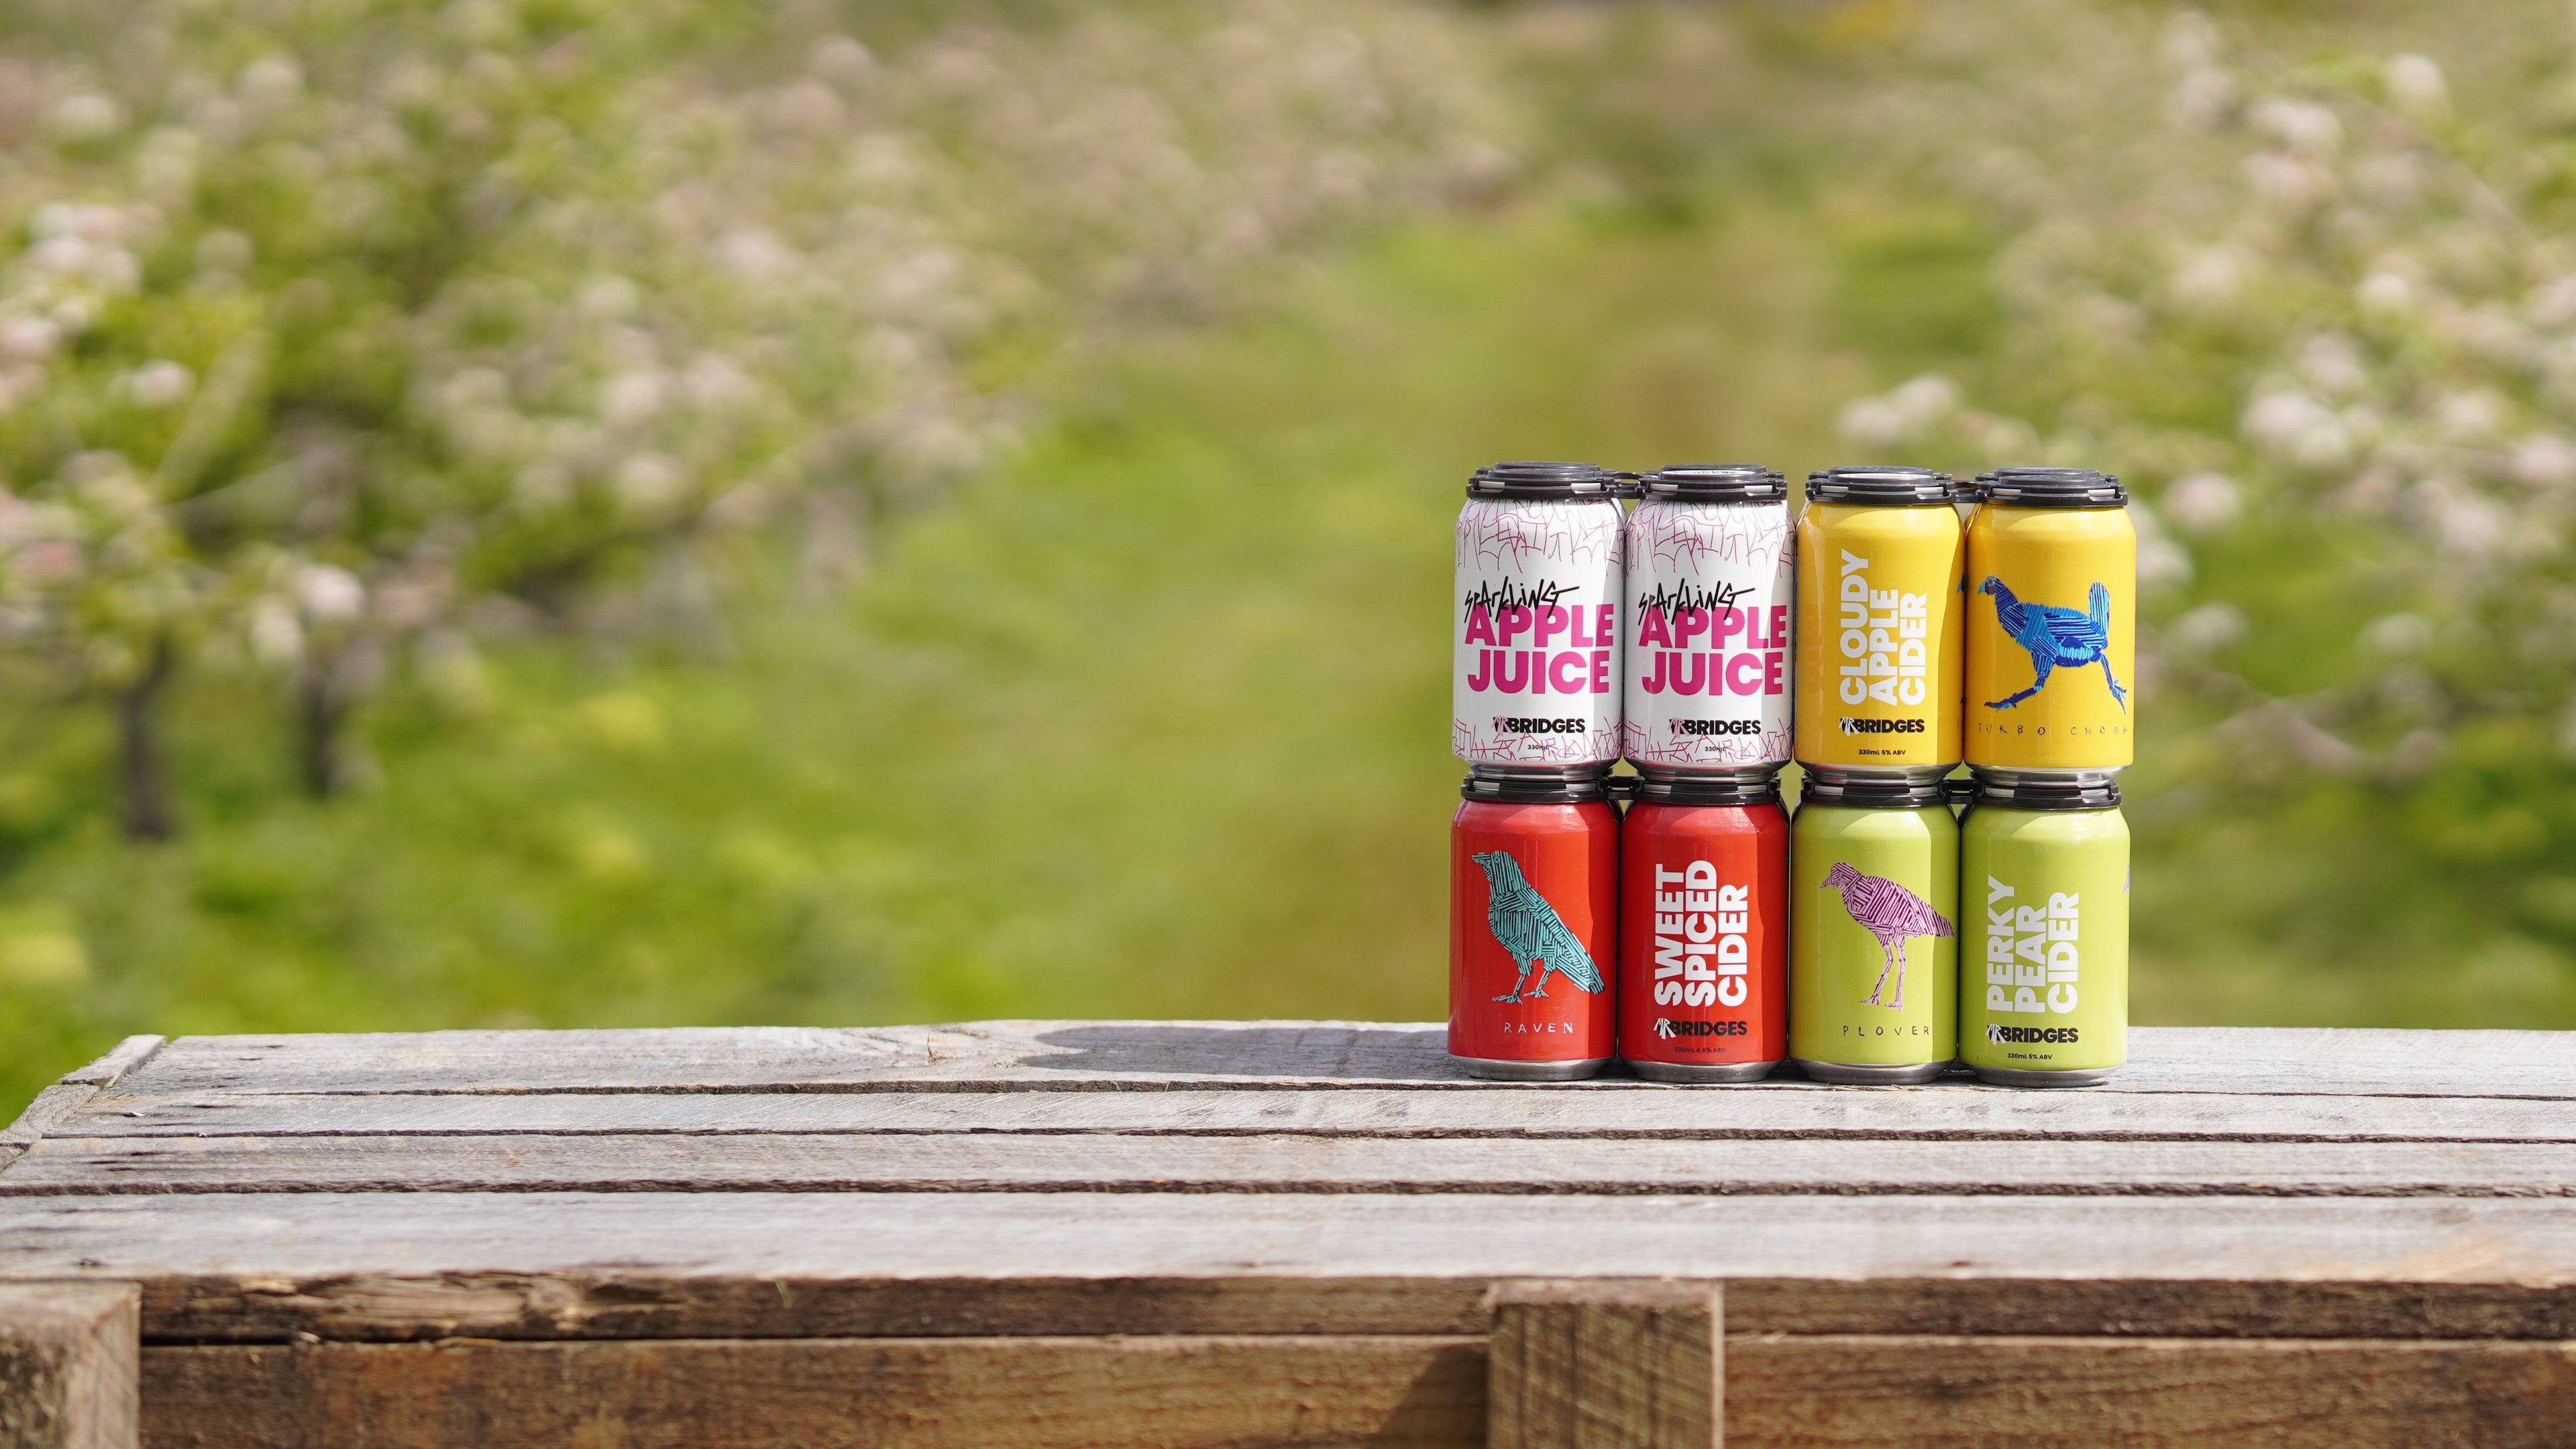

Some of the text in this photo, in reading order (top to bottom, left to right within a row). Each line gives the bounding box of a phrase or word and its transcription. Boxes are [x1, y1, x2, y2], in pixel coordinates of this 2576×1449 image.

[1464, 603, 1615, 648] APPLE
[1638, 604, 1788, 649] APPLE
[1839, 548, 1869, 706] CLOUDY
[1869, 588, 1899, 707] APPLE
[1467, 649, 1610, 694] JUICE
[1898, 592, 1927, 706] CIDER
[1642, 651, 1783, 696] JUICE
[1510, 717, 1586, 734] BRIDGES
[1684, 719, 1762, 735] BRIDGES
[1856, 718, 1925, 734] BRIDGES
[1978, 722, 2127, 736] TURBO CHOOK
[1654, 863, 1684, 1006] SWEET
[1684, 859, 1717, 1008] SPICED
[1717, 883, 1748, 1008] CIDER
[1986, 873, 2015, 1012] PERKY
[2047, 891, 2079, 1014] CIDER
[2015, 904, 2047, 1014] PEAR
[1503, 1021, 1574, 1034] RAVEN
[1670, 1020, 1748, 1037] BRIDGES
[1843, 1025, 1930, 1037] PLOVER
[2000, 1026, 2079, 1043] BRIDGES
